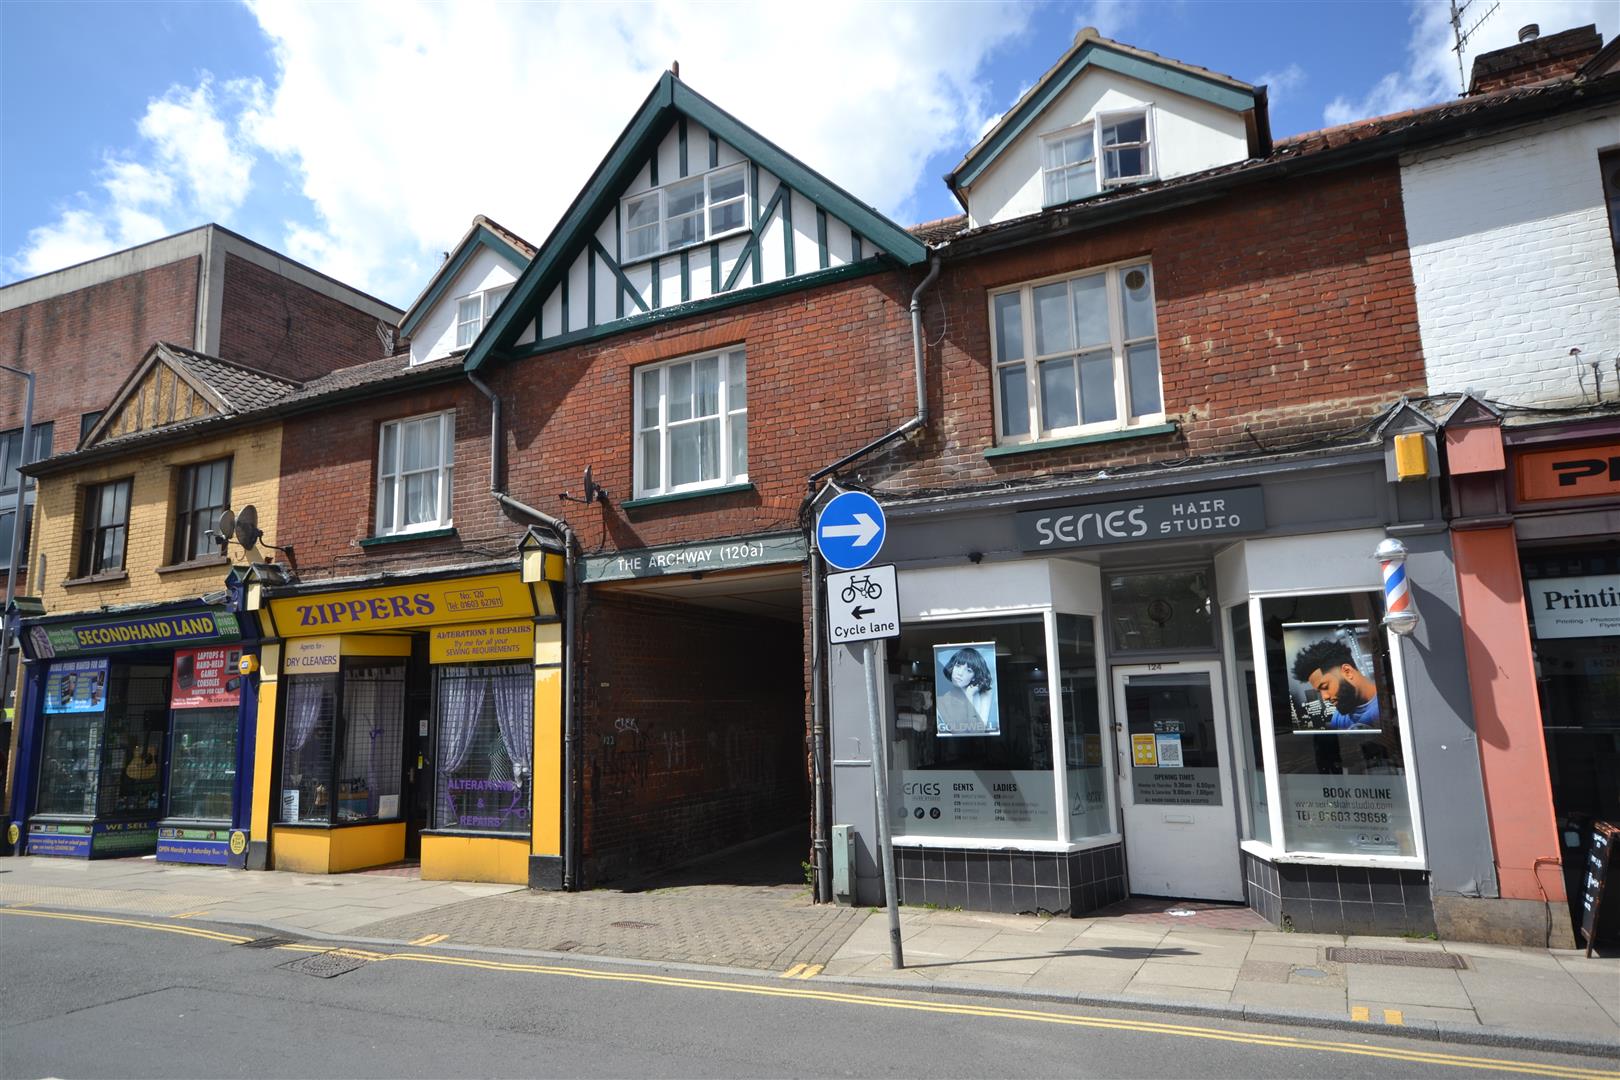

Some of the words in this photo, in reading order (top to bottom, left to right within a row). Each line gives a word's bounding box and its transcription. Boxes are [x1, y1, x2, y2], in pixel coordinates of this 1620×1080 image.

[1552, 457, 1620, 486] P
[1172, 499, 1225, 516] HAIR
[1160, 514, 1241, 533] STUDIO
[618, 558, 642, 571] THE
[649, 549, 712, 568] ARCHWAY
[720, 543, 763, 561] (120a)
[473, 590, 484, 599] 120
[1543, 586, 1620, 610] Printi
[297, 593, 436, 626] ZIPPERS
[78, 620, 171, 646] SECONDHAND
[172, 617, 214, 636] LAND
[436, 628, 487, 639] ALTERATIONS
[496, 625, 531, 635] REPAIRS
[834, 622, 865, 638] Cycle
[870, 620, 895, 633] lane
[197, 651, 219, 660] LAPTOPS
[446, 648, 469, 656] SEWING
[472, 645, 519, 655] REQUIREMENTS
[286, 657, 300, 667] DRY
[302, 655, 337, 666] CLEANERS
[1148, 663, 1162, 671] 124
[201, 669, 218, 677] GAMES
[938, 720, 997, 732] GOLDWELL
[448, 778, 514, 792] ALTERATIONS
[953, 783, 974, 792] GENTS
[993, 783, 1018, 792] LADIES
[1322, 787, 1352, 798] BOOK
[1354, 788, 1392, 800] ONLINE
[477, 798, 485, 809] &
[105, 823, 123, 831] WE
[460, 815, 501, 827] REPAIRS
